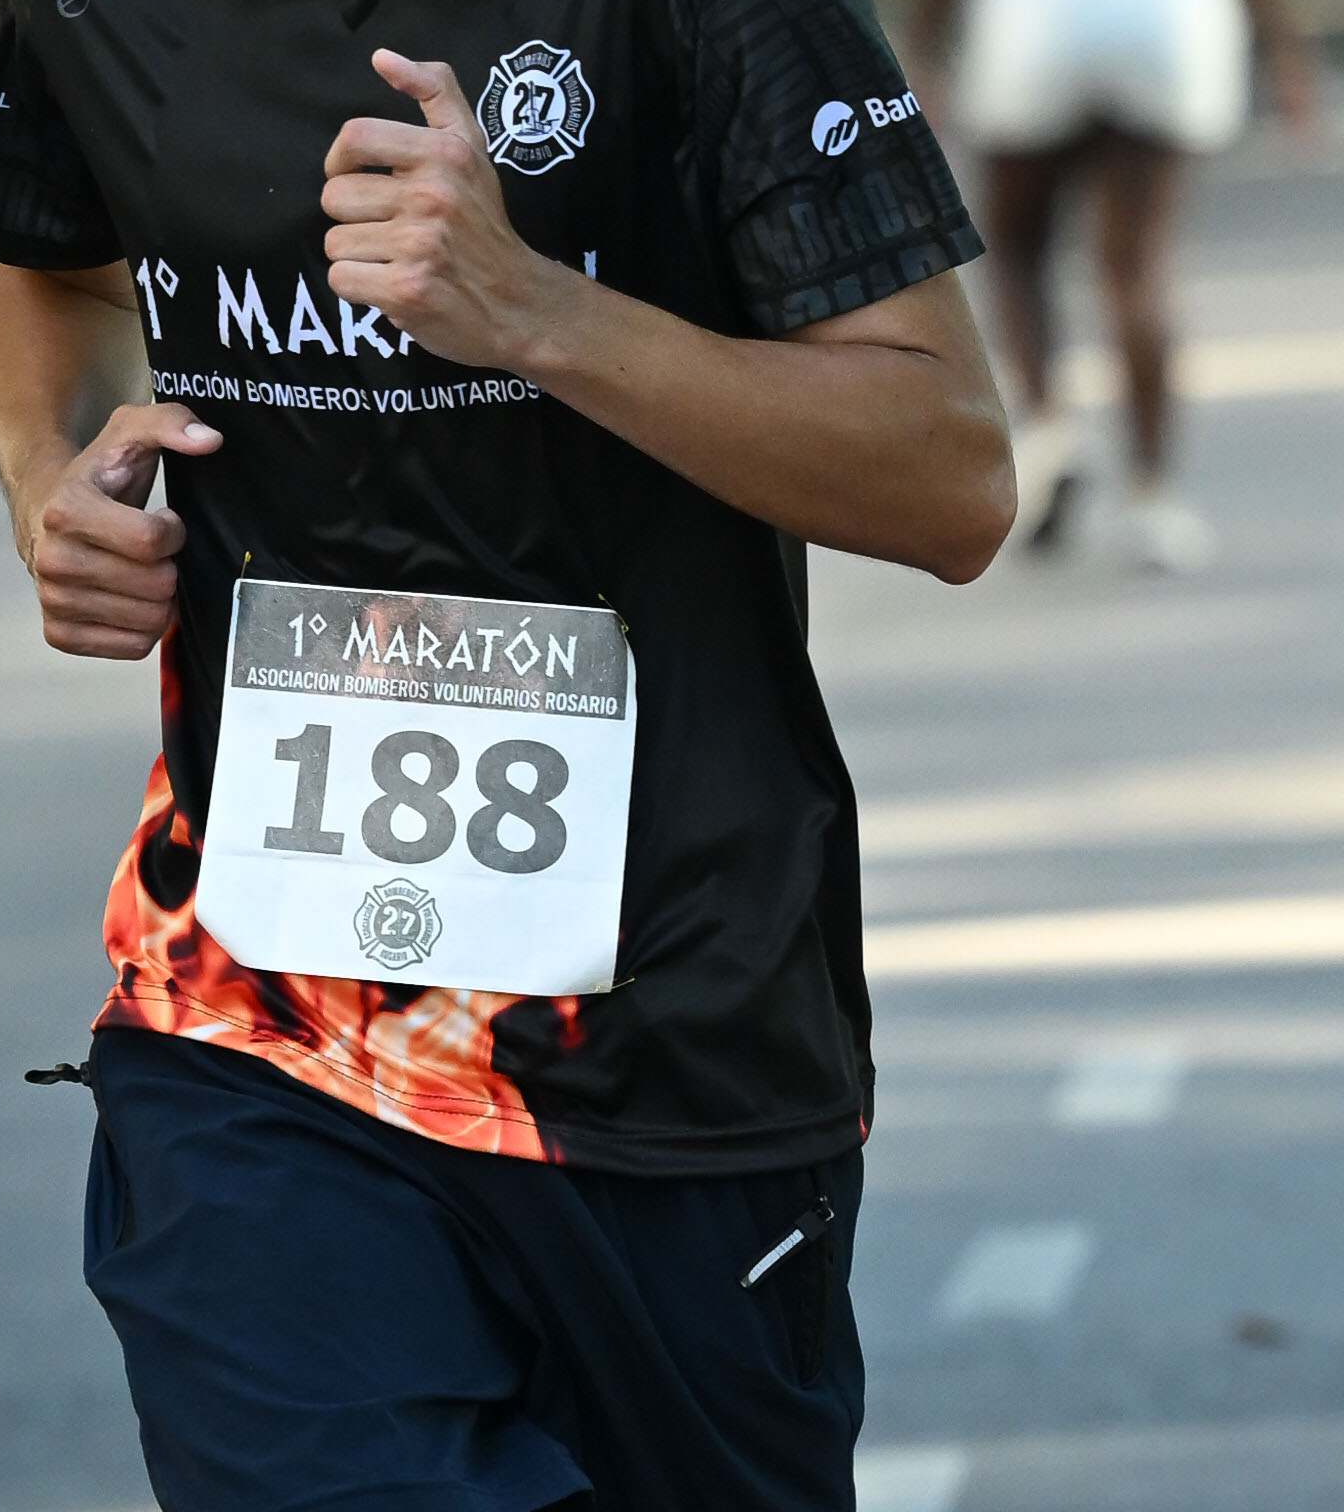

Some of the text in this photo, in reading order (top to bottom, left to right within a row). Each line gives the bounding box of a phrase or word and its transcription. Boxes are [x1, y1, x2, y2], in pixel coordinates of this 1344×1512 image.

[513, 81, 555, 126] 27
[153, 369, 240, 401] OCIACIÓN
[342, 616, 578, 680] MARATÓN
[344, 674, 429, 700] BOMBEROS
[433, 682, 540, 709] VOLUNTARIOS
[545, 691, 618, 716] ROSARIO
[263, 723, 570, 875] 188
[380, 905, 416, 936] 27
